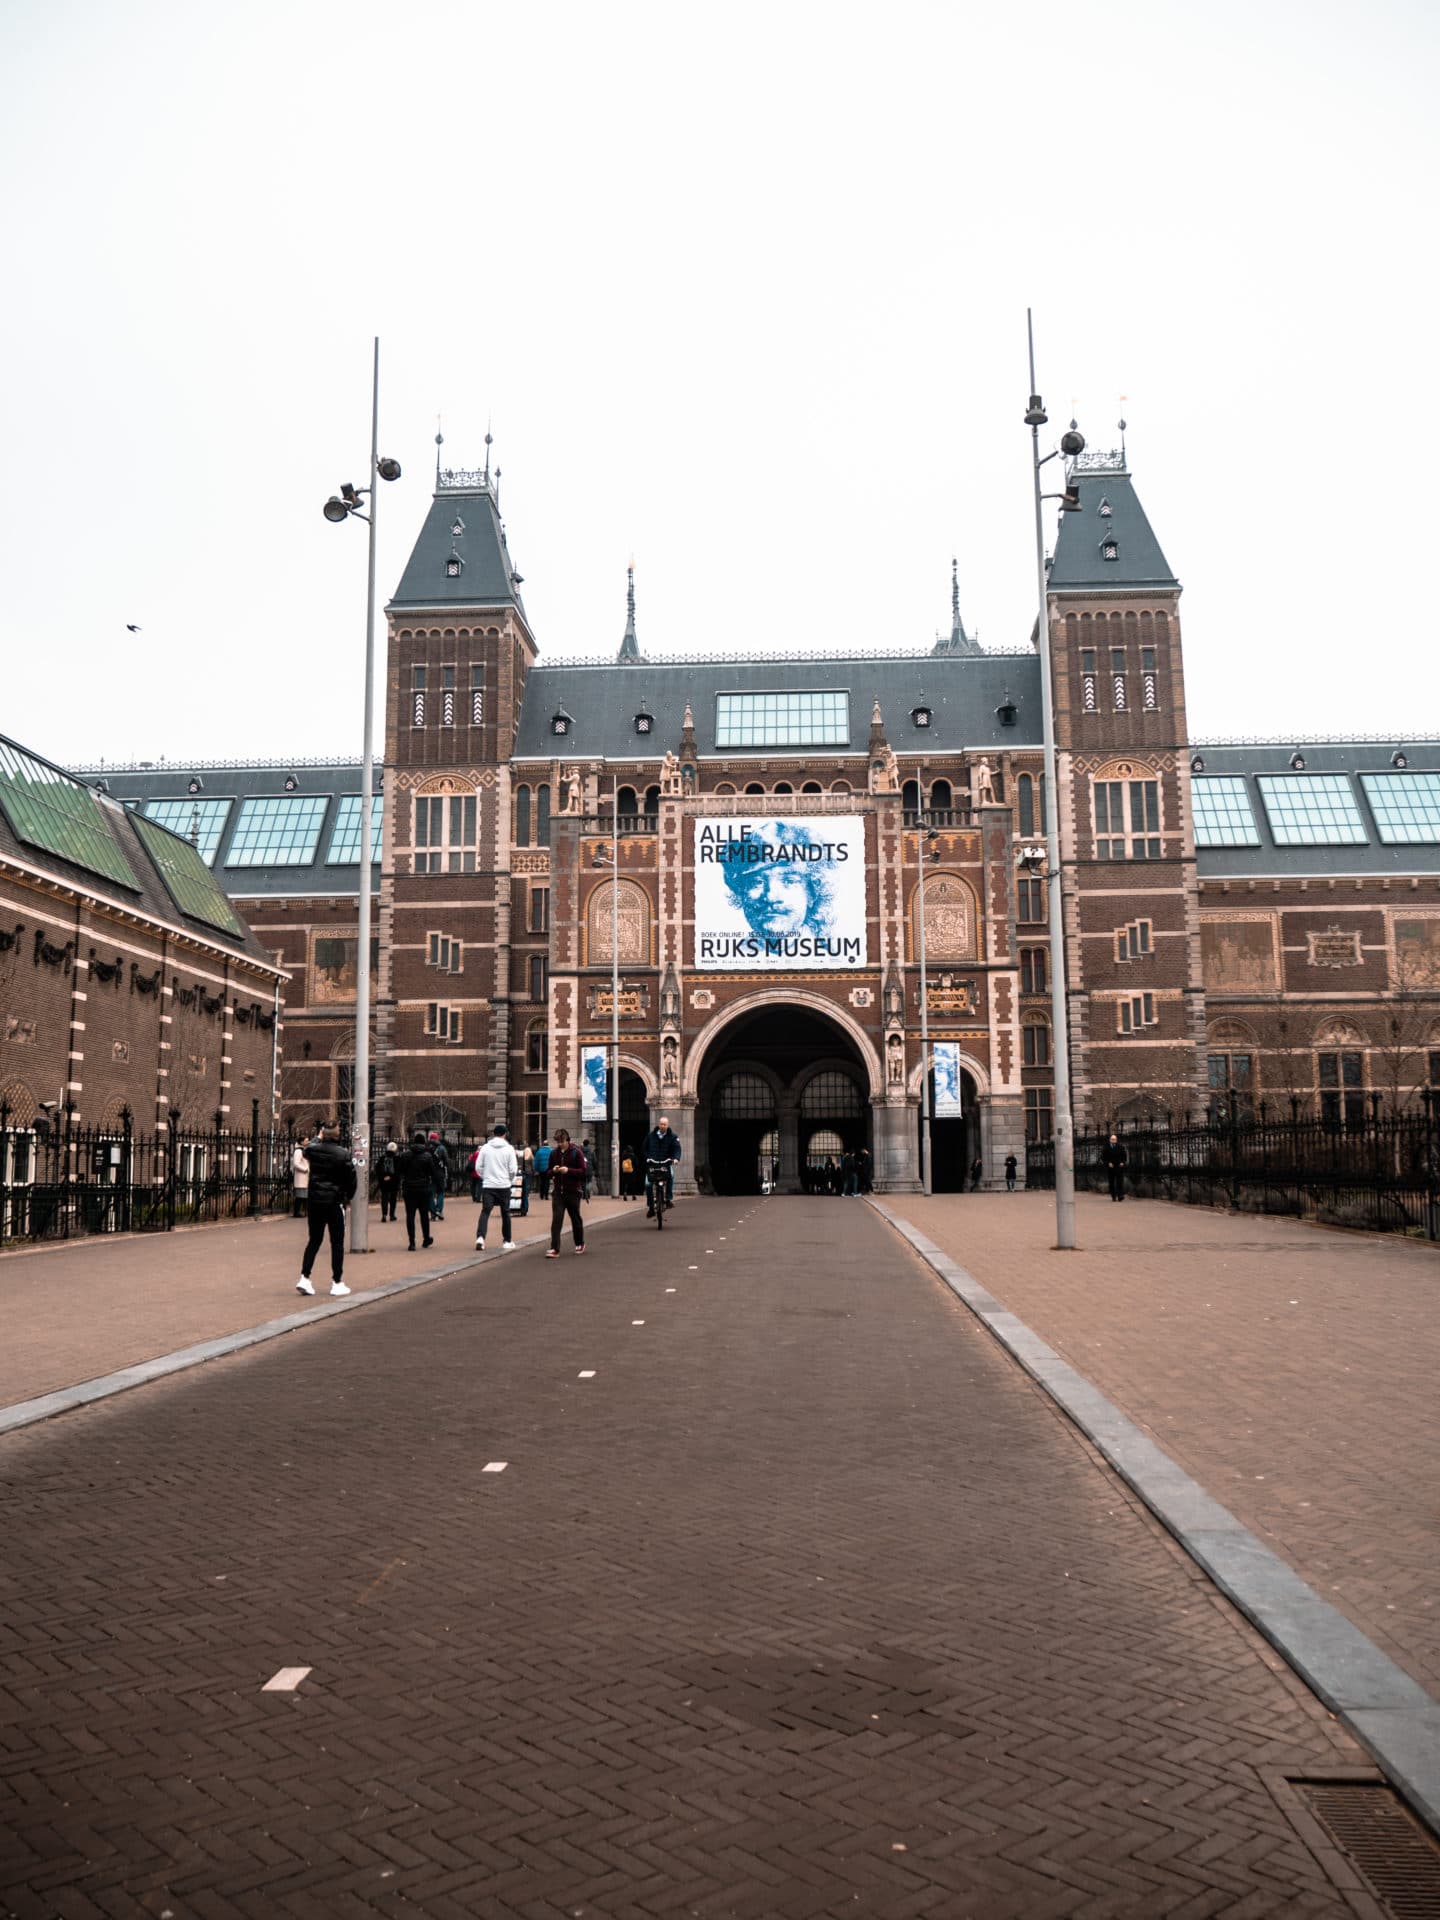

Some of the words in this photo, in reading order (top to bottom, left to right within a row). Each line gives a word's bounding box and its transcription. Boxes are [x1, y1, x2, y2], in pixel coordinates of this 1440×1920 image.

[700, 825, 752, 843] ALLE
[701, 843, 849, 863] REMBRANDTS
[765, 937, 860, 957] MUSEUM
